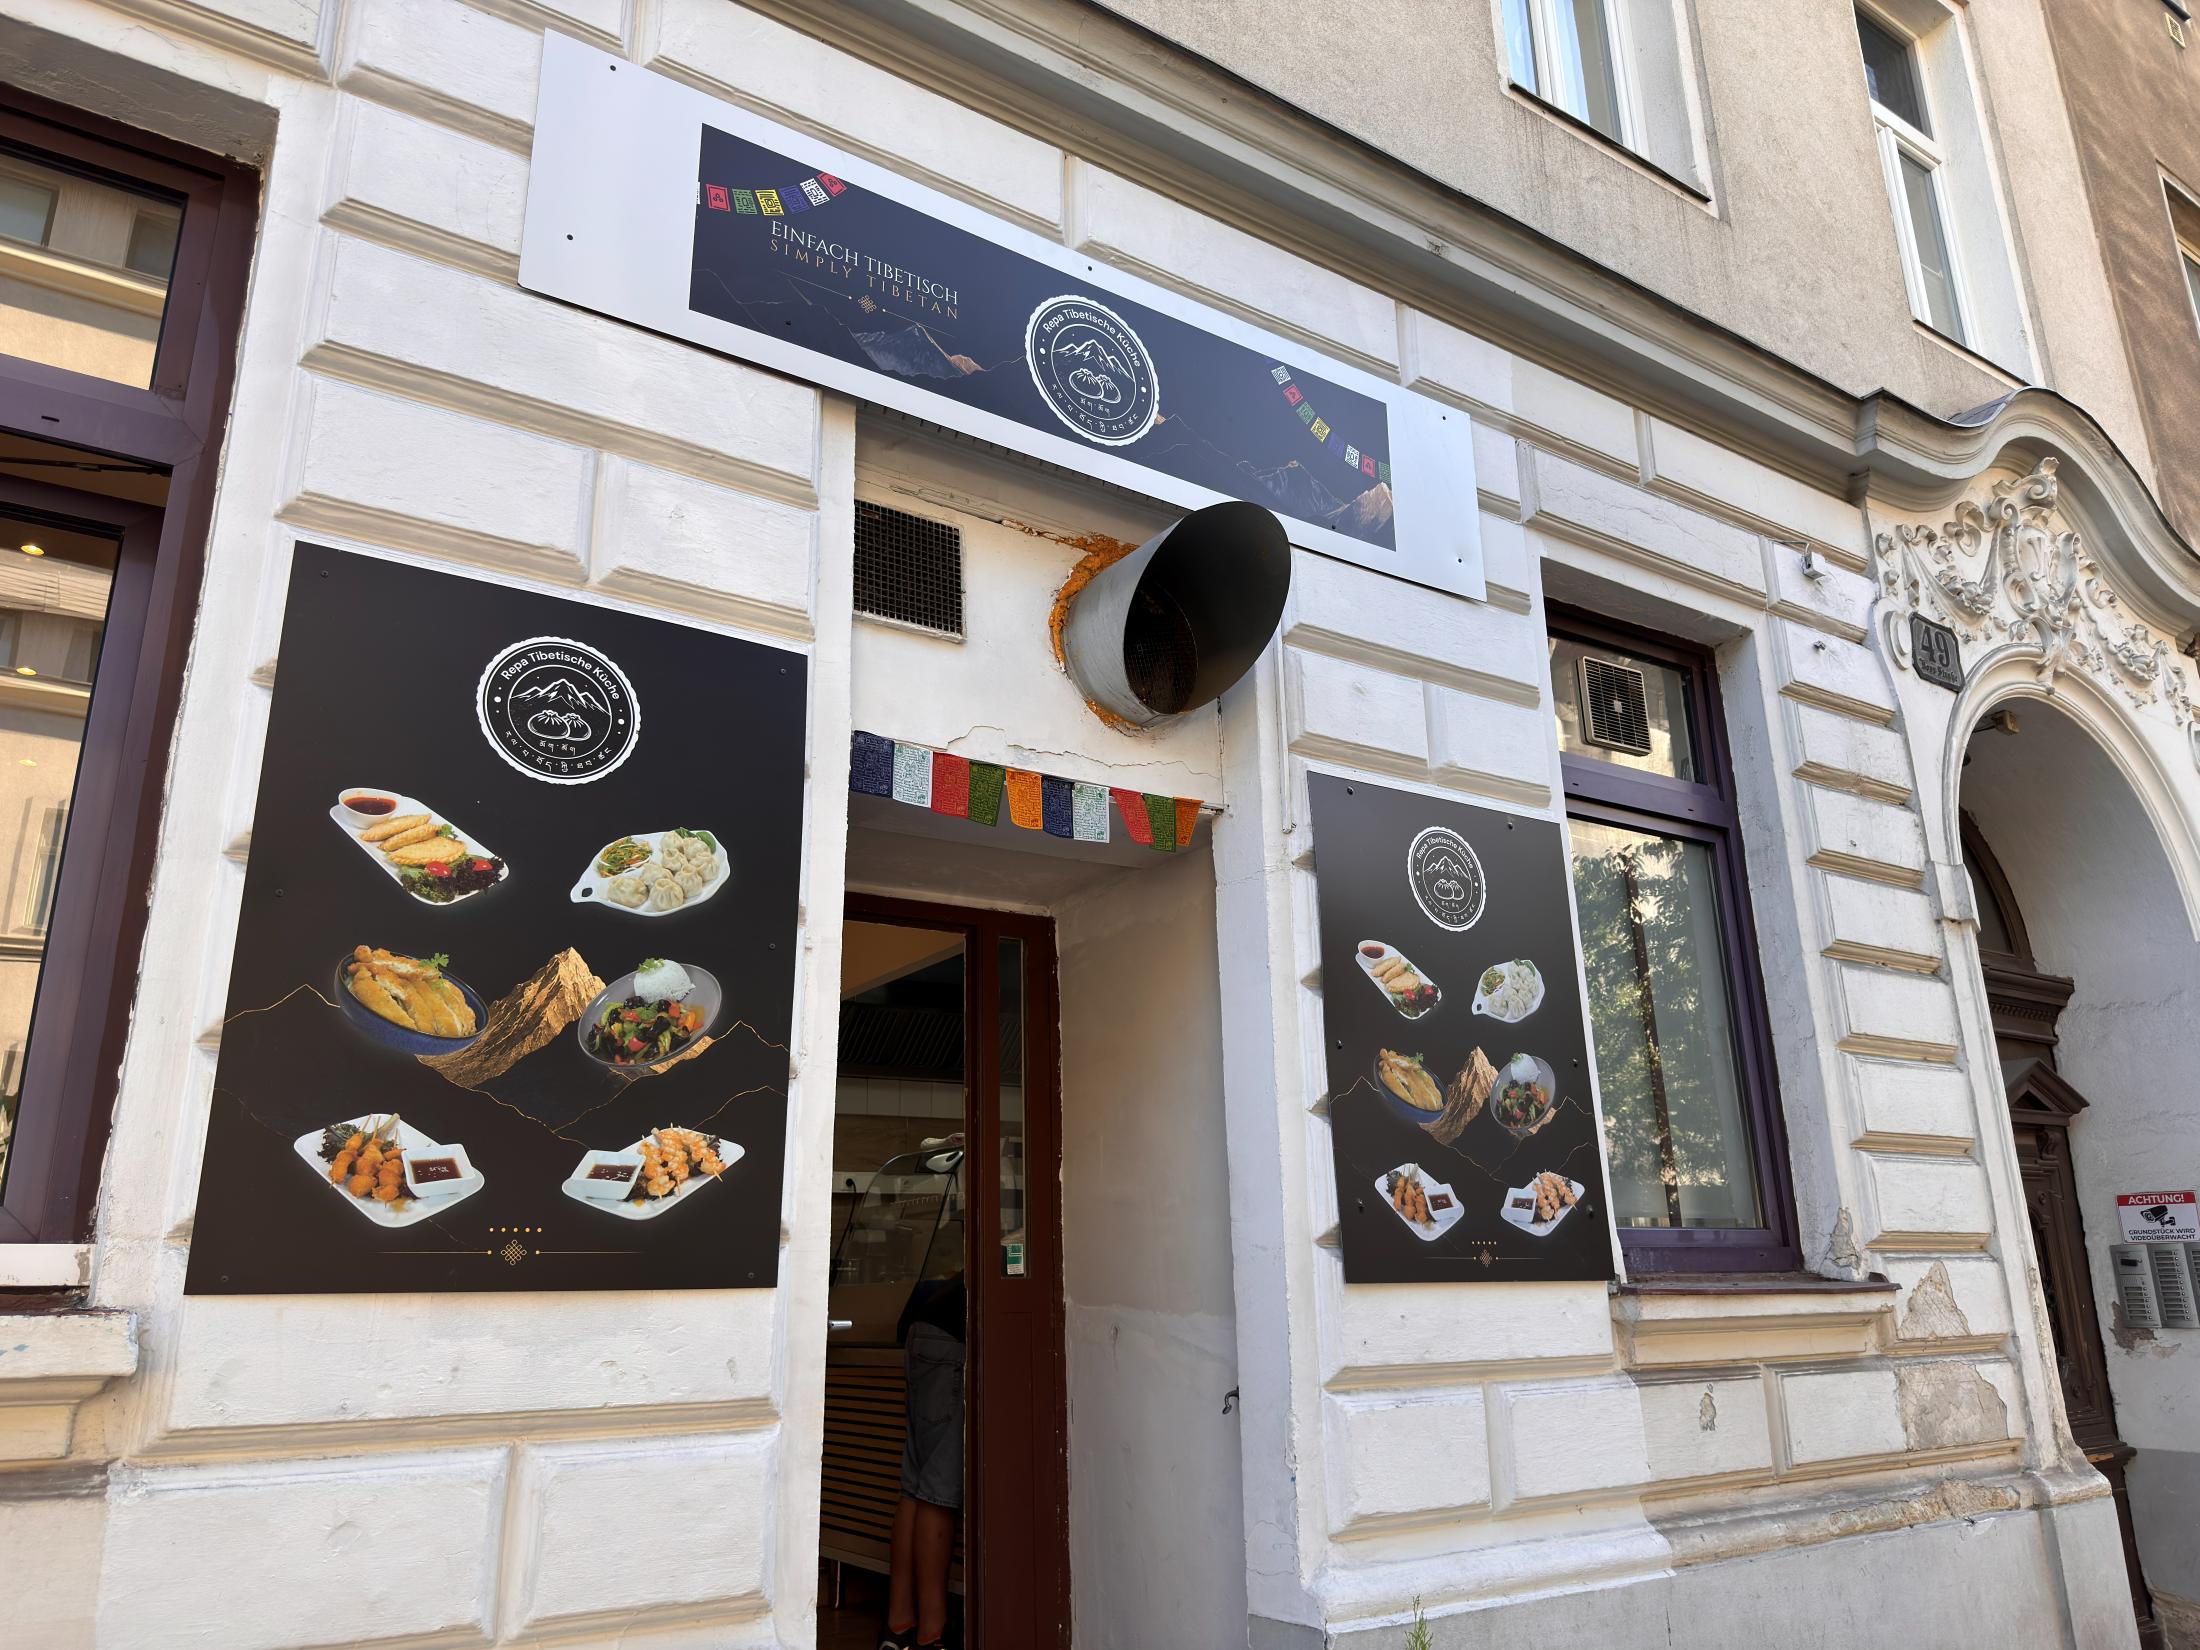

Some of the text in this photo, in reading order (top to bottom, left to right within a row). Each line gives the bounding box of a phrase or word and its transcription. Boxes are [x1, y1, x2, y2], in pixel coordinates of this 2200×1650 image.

[770, 239, 958, 320] SIMPLY TIBETAN
[771, 220, 959, 305] EINFACH TIBETISCH
[1042, 309, 1141, 368] Repa Tibetische Küche
[1921, 625, 1951, 668] 49
[500, 651, 620, 701] Repa Tibetische Küche
[1416, 836, 1474, 869] Repa Tibetische Küche
[2128, 1193, 2185, 1205] ACHTUNG!
